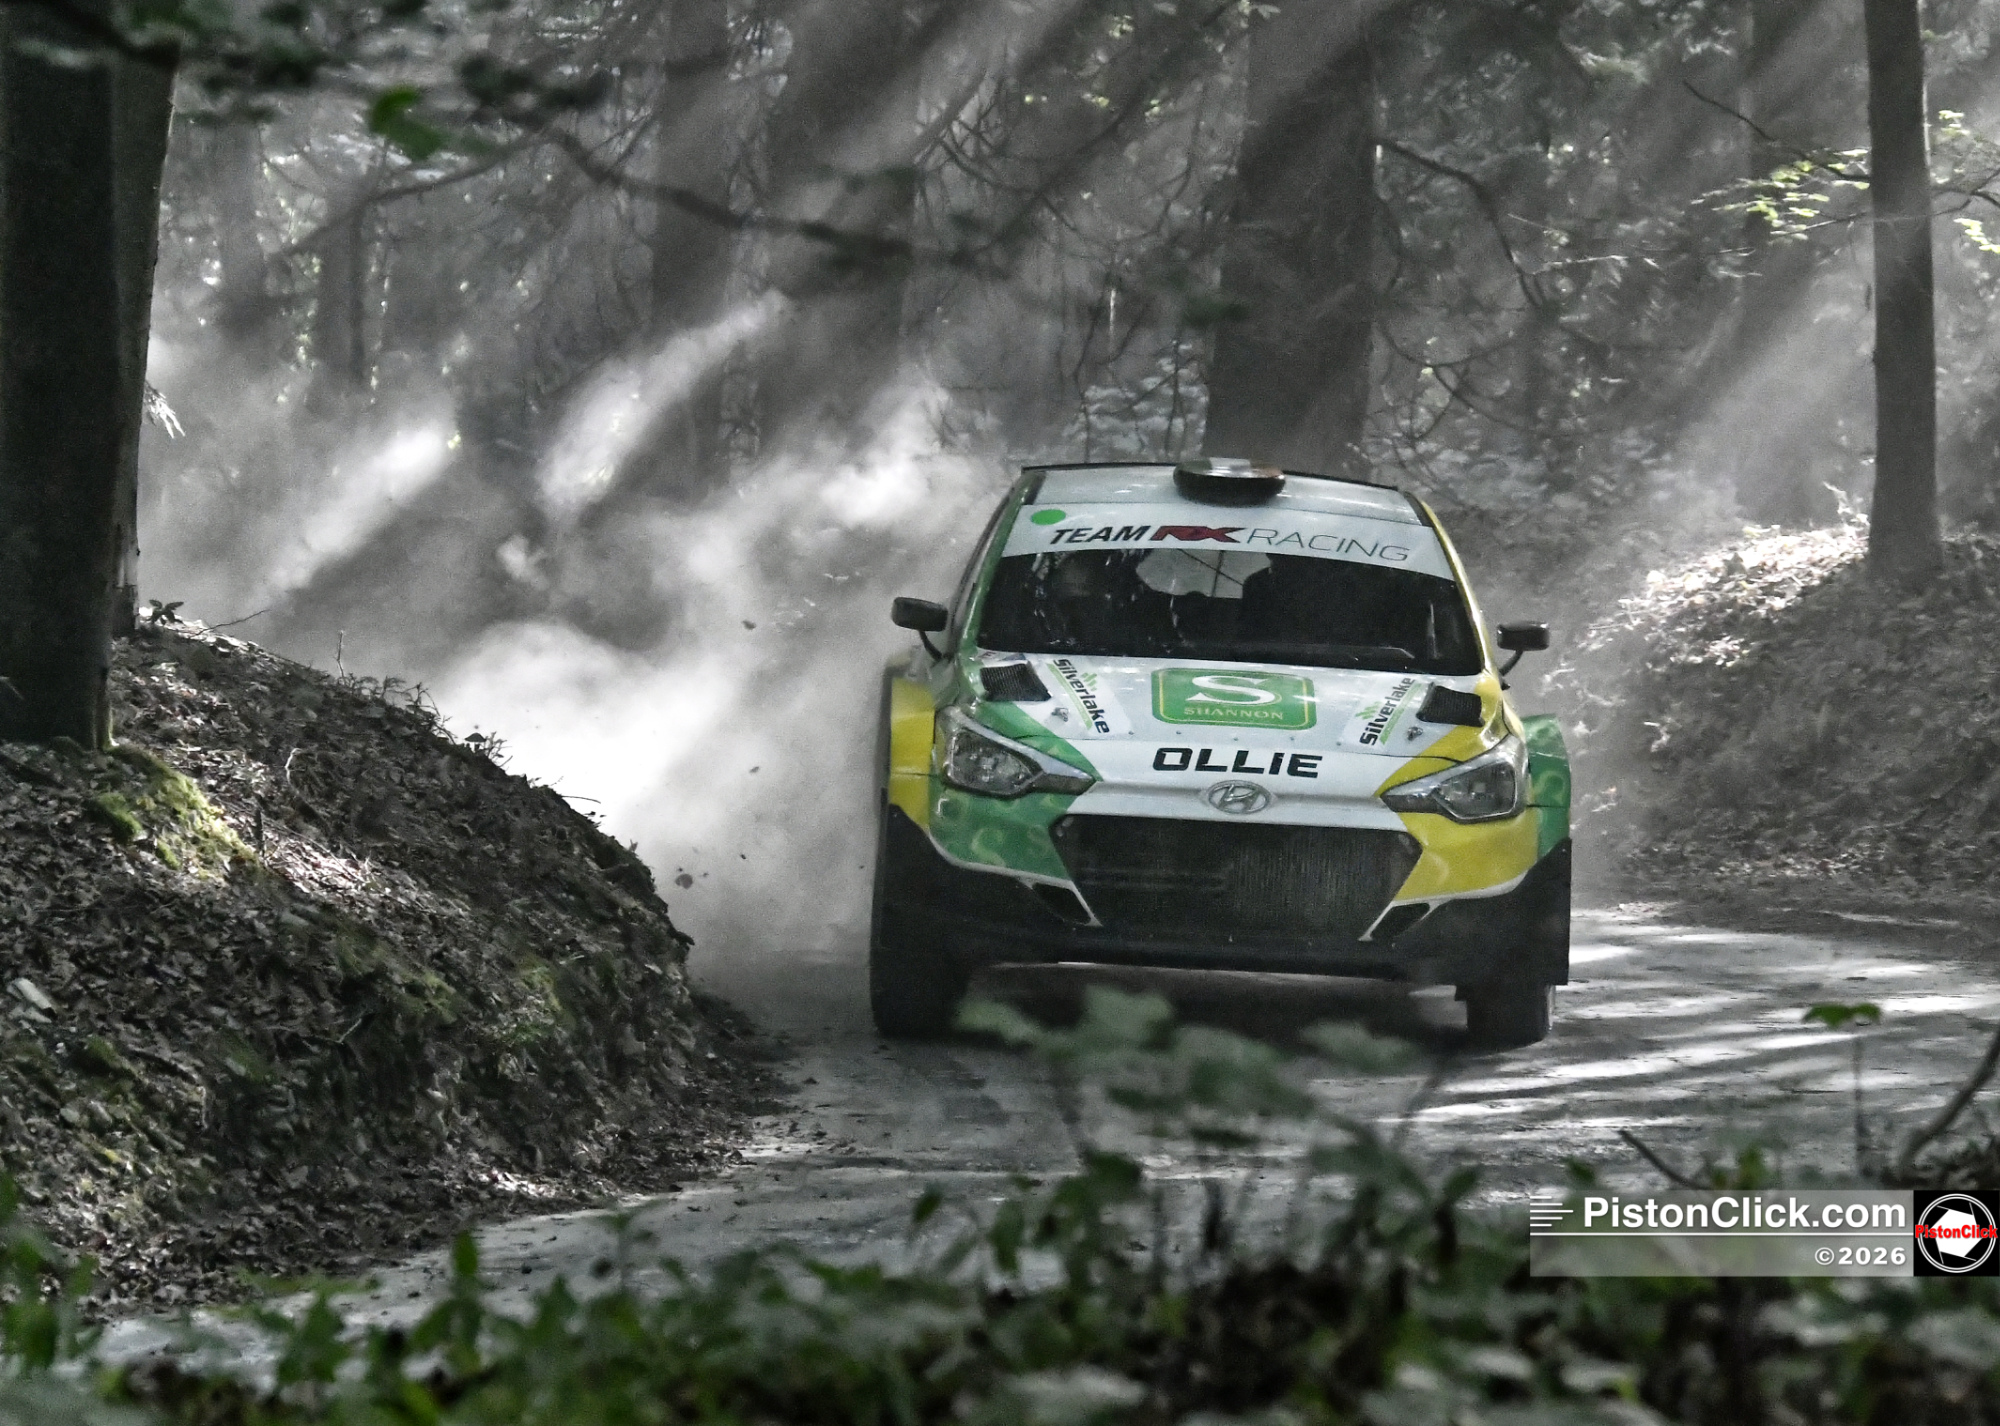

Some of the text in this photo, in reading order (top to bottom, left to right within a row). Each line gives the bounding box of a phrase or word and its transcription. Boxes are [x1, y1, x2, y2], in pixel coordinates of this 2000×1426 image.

[1050, 525, 1151, 545] TEAM
[1247, 527, 1411, 562] RACING
[1053, 658, 1110, 734] Silverlake
[1184, 706, 1284, 720] SHANNON
[1359, 677, 1416, 746] Silverlake
[1152, 747, 1323, 779] OLLIE
